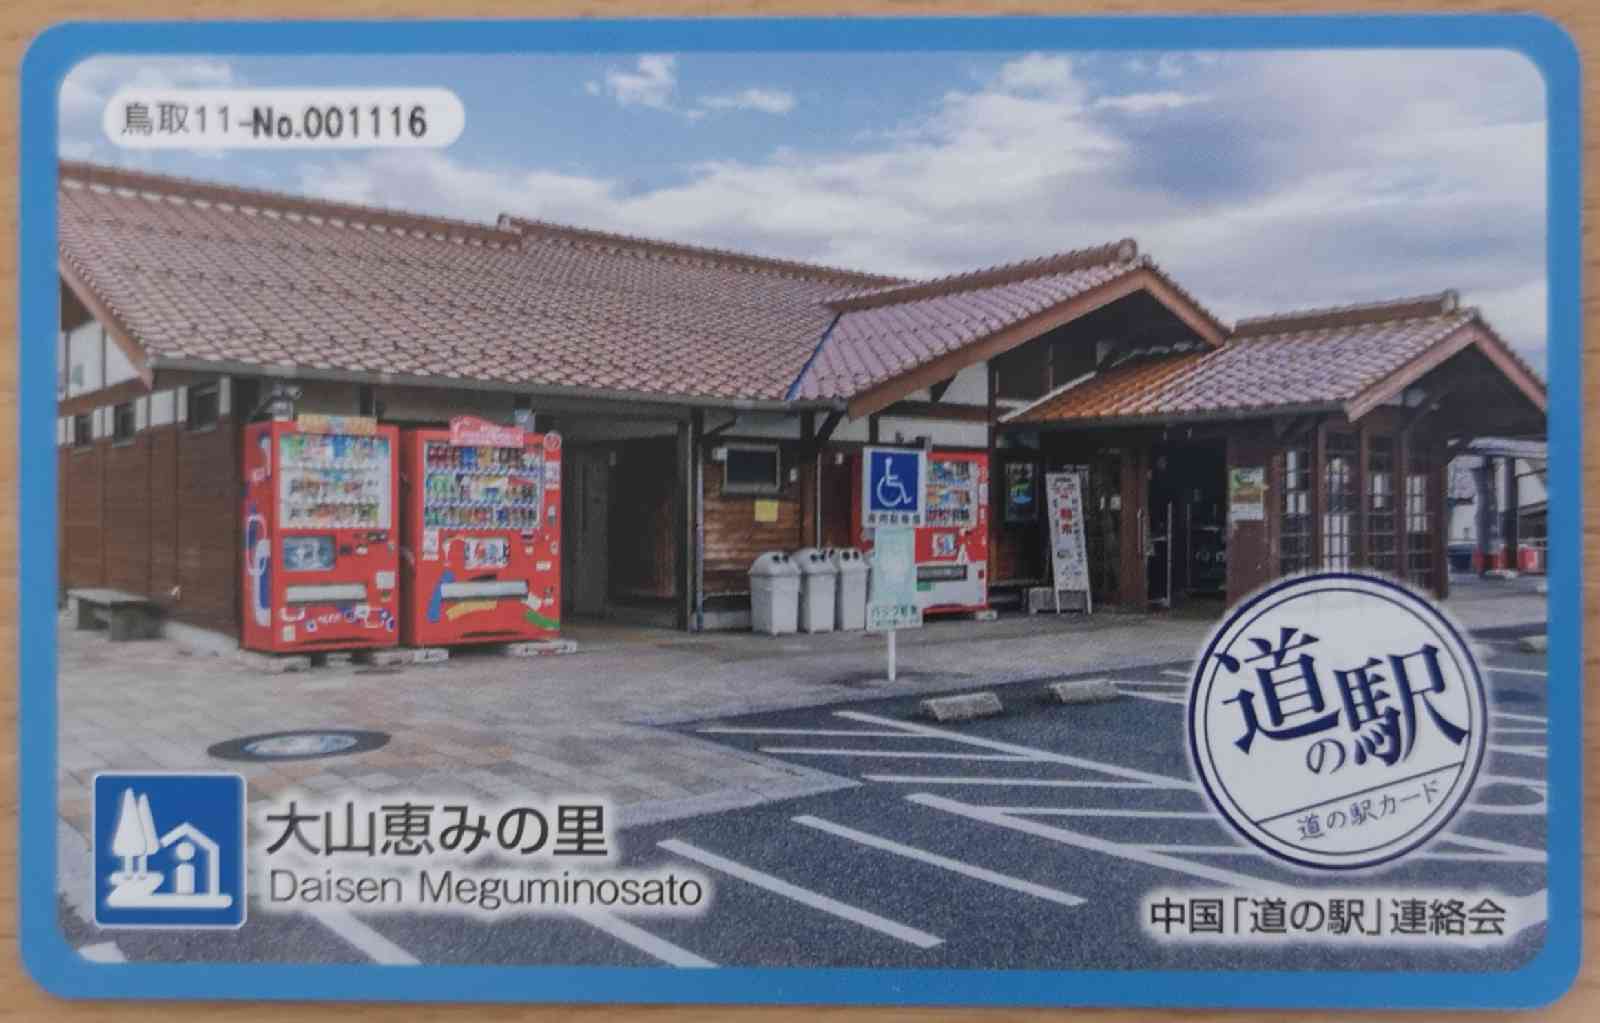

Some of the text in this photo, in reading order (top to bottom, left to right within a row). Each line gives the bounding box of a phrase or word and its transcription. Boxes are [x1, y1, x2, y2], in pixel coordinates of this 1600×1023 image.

[1214, 627, 1470, 775] 道の駅
[265, 803, 608, 856] 大山恵みの里
[1298, 782, 1440, 839] 道の駅カード
[268, 869, 704, 910] Daisen Meguminosato
[1151, 898, 1506, 936] 中国「道の駅」連絡会
